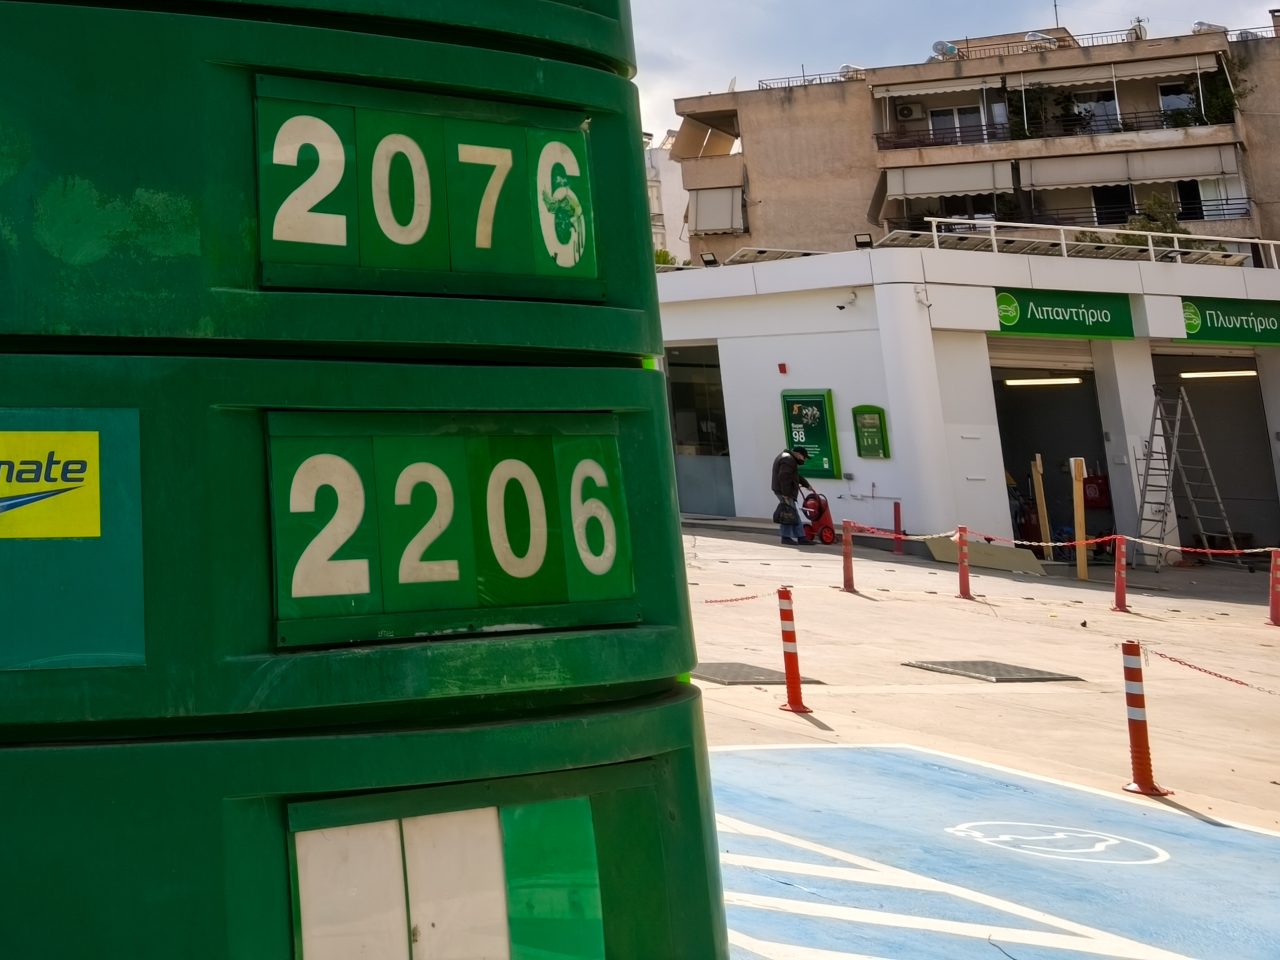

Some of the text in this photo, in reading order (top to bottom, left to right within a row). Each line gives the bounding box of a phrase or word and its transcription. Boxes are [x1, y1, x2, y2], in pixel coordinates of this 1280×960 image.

[272, 114, 586, 268] 2076
[1027, 302, 1111, 326] Λιπαντήριο
[1205, 310, 1279, 333] Πλυντήριο
[792, 430, 806, 442] 98
[289, 452, 617, 599] 2206
